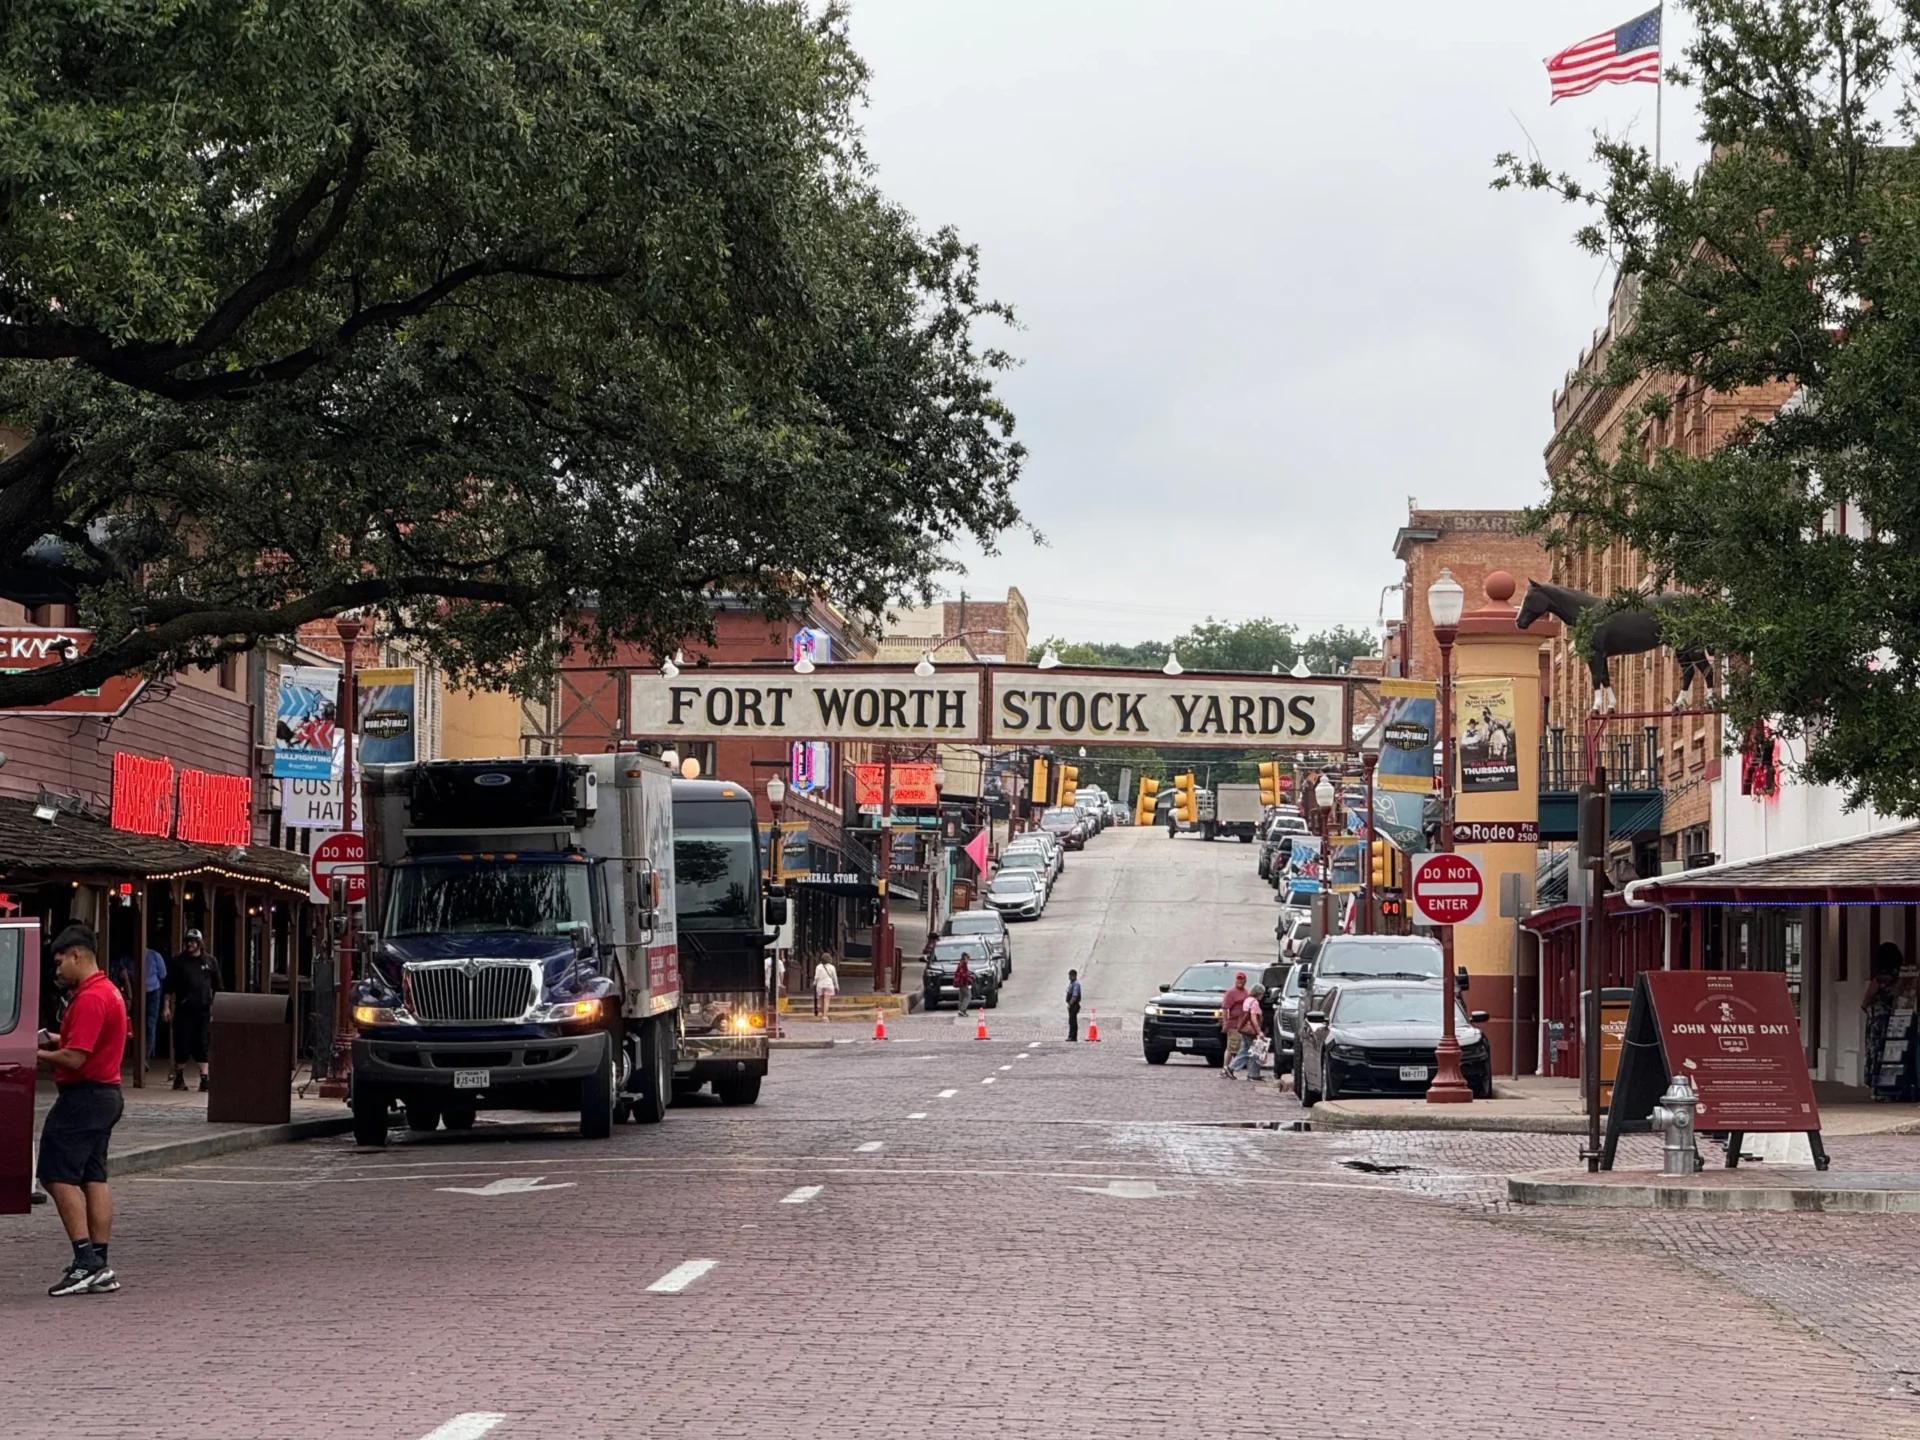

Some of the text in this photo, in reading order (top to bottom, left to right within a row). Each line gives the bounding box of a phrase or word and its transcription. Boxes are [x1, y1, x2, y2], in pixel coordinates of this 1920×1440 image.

[667, 687, 967, 729] FORT WORTH
[1002, 690, 1316, 737] STOCK YARDS
[275, 753, 332, 763] BULLFIGHTING
[1463, 766, 1516, 775] THURSDAYS
[1279, 781, 1293, 789] STOP
[1472, 823, 1533, 840] Rodeo Plz
[1517, 833, 1538, 842] 2500
[322, 847, 364, 858] DO NO
[904, 864, 920, 872] Main
[1423, 868, 1473, 879] DO NOT
[326, 877, 366, 889] EER
[797, 873, 858, 884] GENERAL STORE
[1428, 898, 1468, 911] ENTER
[1671, 1024, 1789, 1035] JOHN WAYNE DAY!
